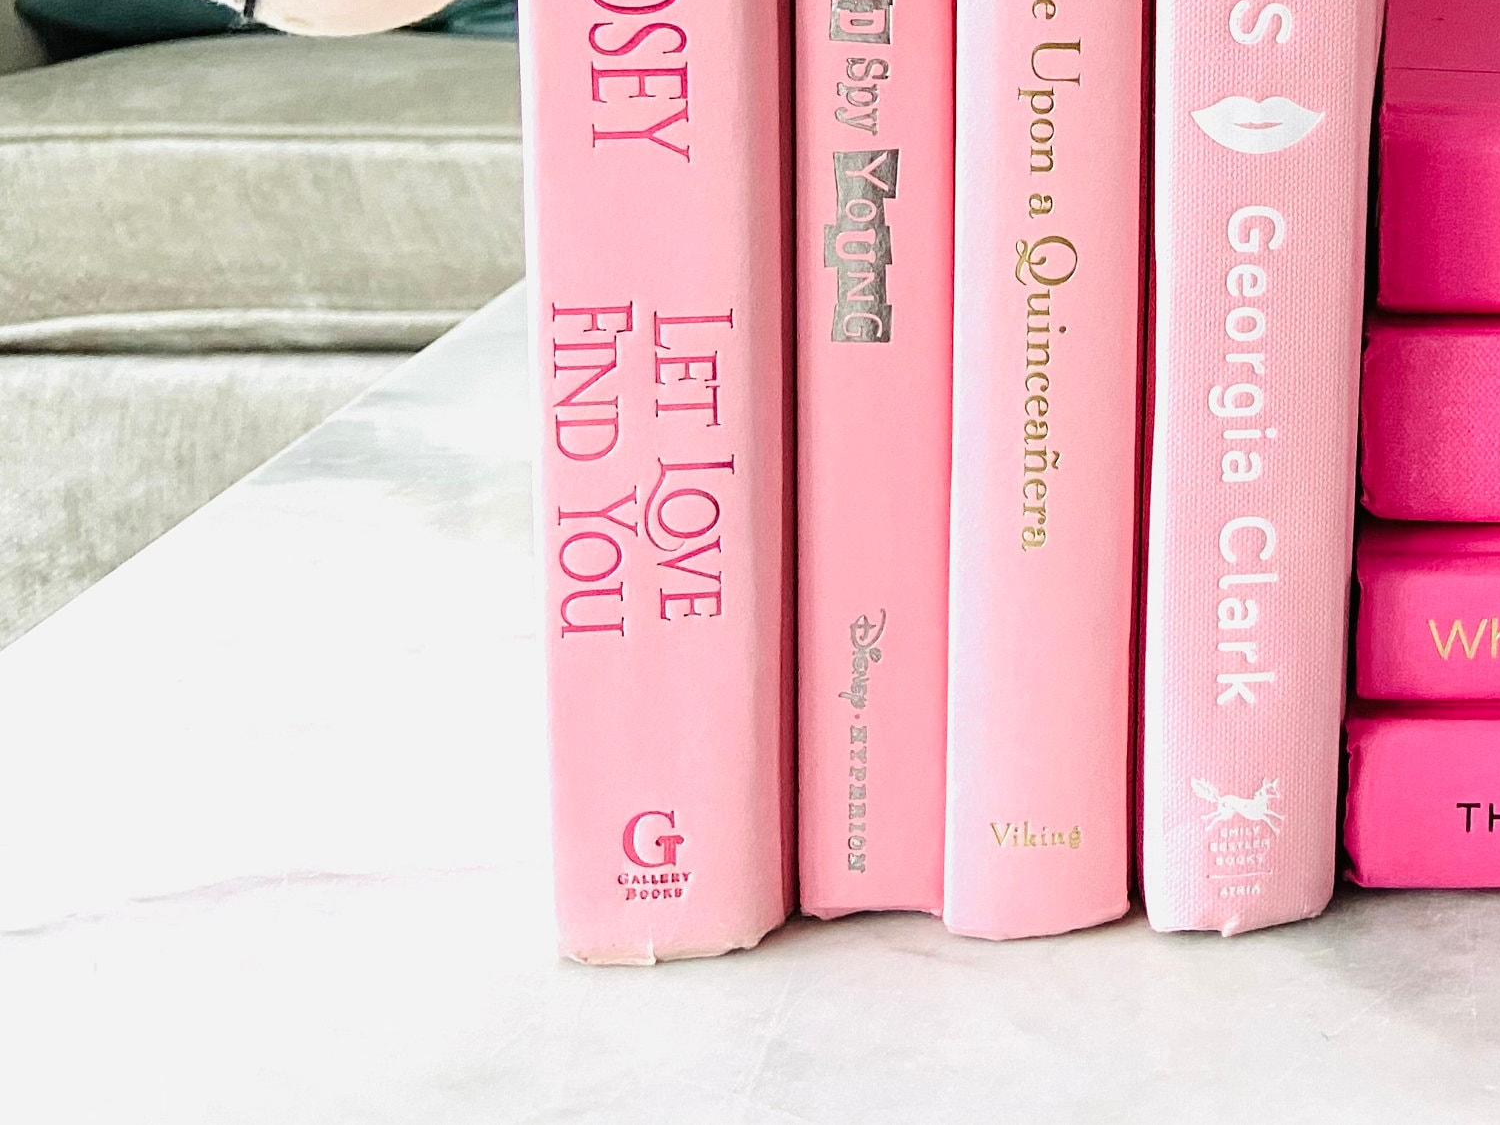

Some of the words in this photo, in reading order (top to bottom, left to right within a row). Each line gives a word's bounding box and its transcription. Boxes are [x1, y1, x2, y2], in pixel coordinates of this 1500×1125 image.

[835, 57, 889, 136] Spy
[1019, 38, 1081, 177] Upon
[1028, 193, 1054, 218] a
[552, 301, 633, 462] FIND
[654, 308, 733, 426] LET
[1013, 235, 1079, 552] Quinceañera
[1209, 204, 1286, 483] Georgia
[558, 485, 638, 638] YOU
[644, 454, 735, 621] LOVE
[1217, 516, 1277, 707] Clark
[990, 821, 1081, 849] Viking
